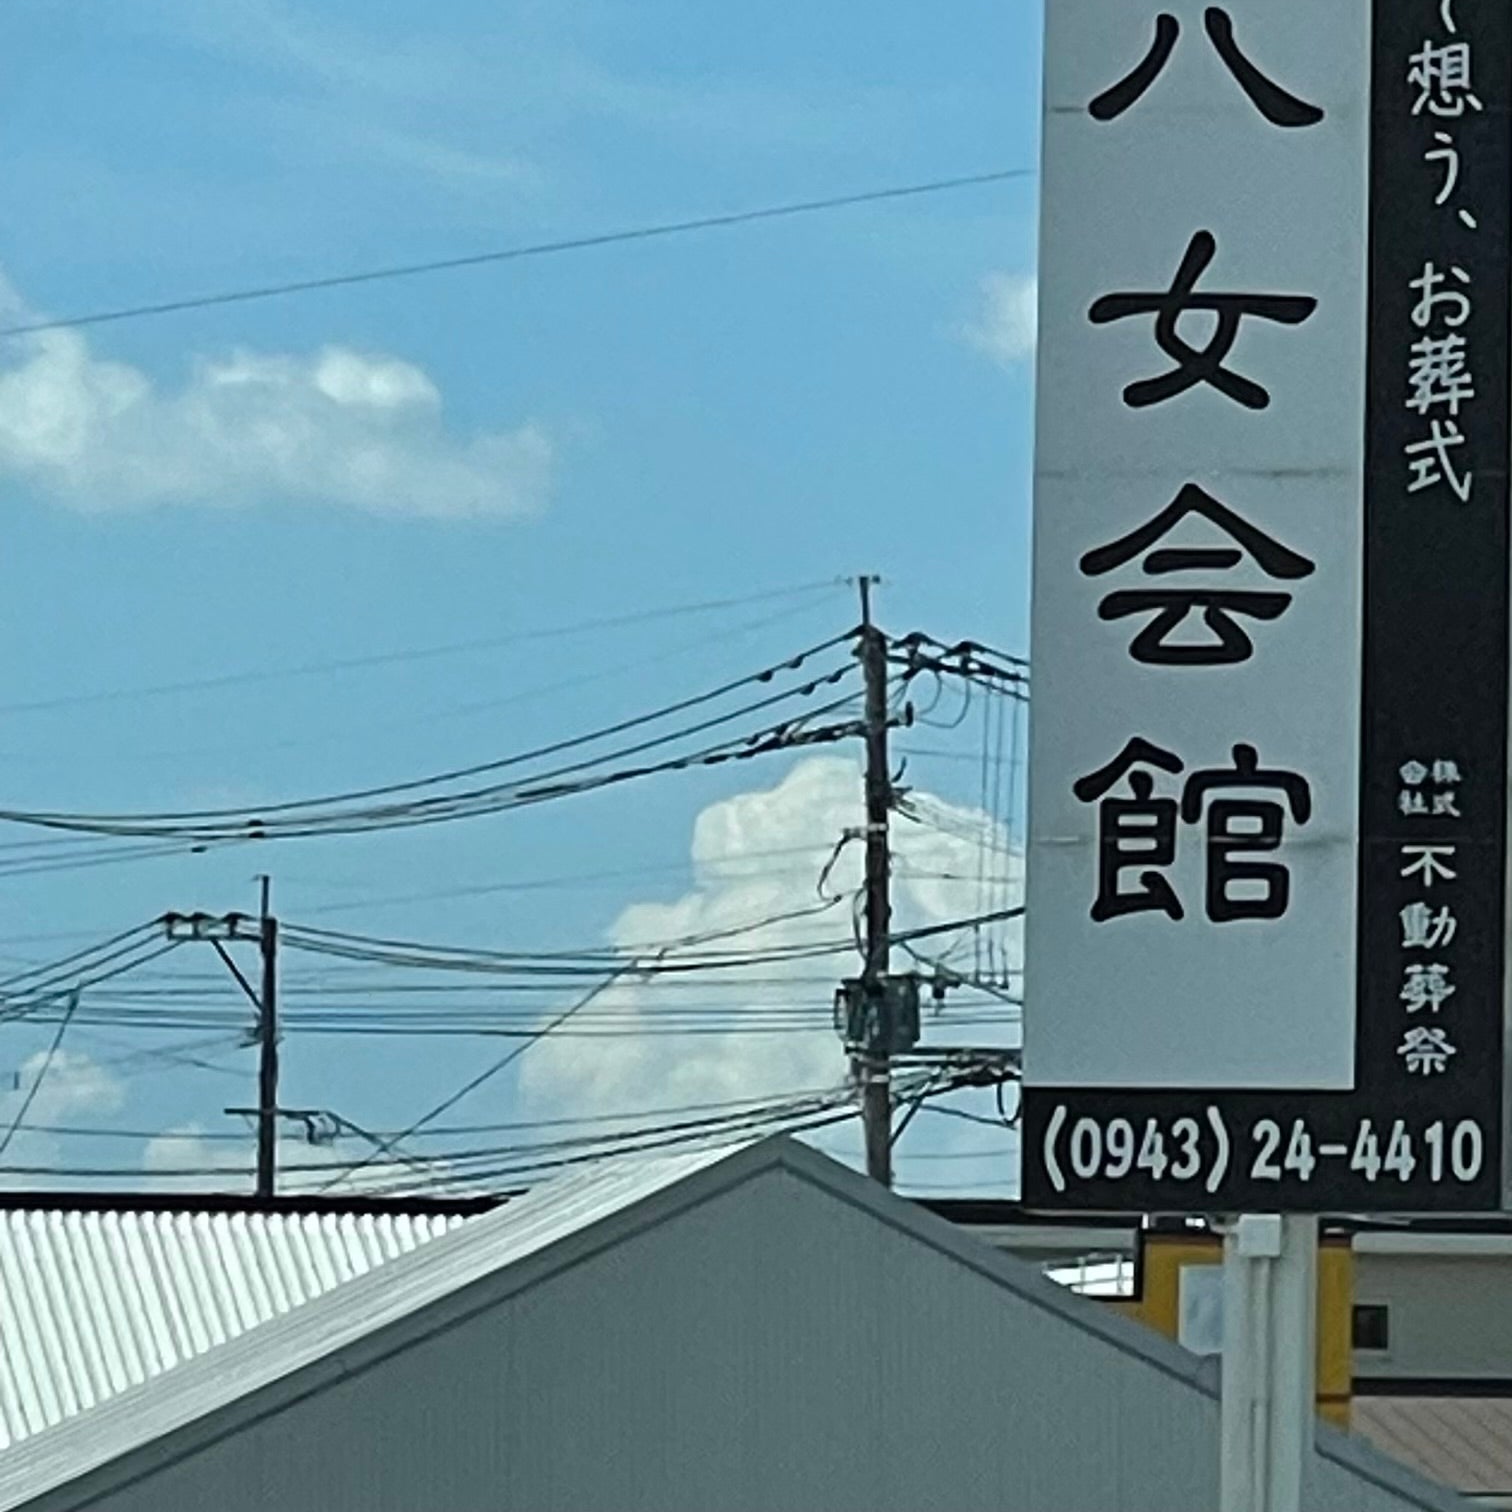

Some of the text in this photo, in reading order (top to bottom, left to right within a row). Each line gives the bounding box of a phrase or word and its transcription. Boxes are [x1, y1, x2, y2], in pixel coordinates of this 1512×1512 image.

[1073, 6, 1324, 923] 八女会館
[1044, 1105, 1483, 1193] (0943) 24-4410
